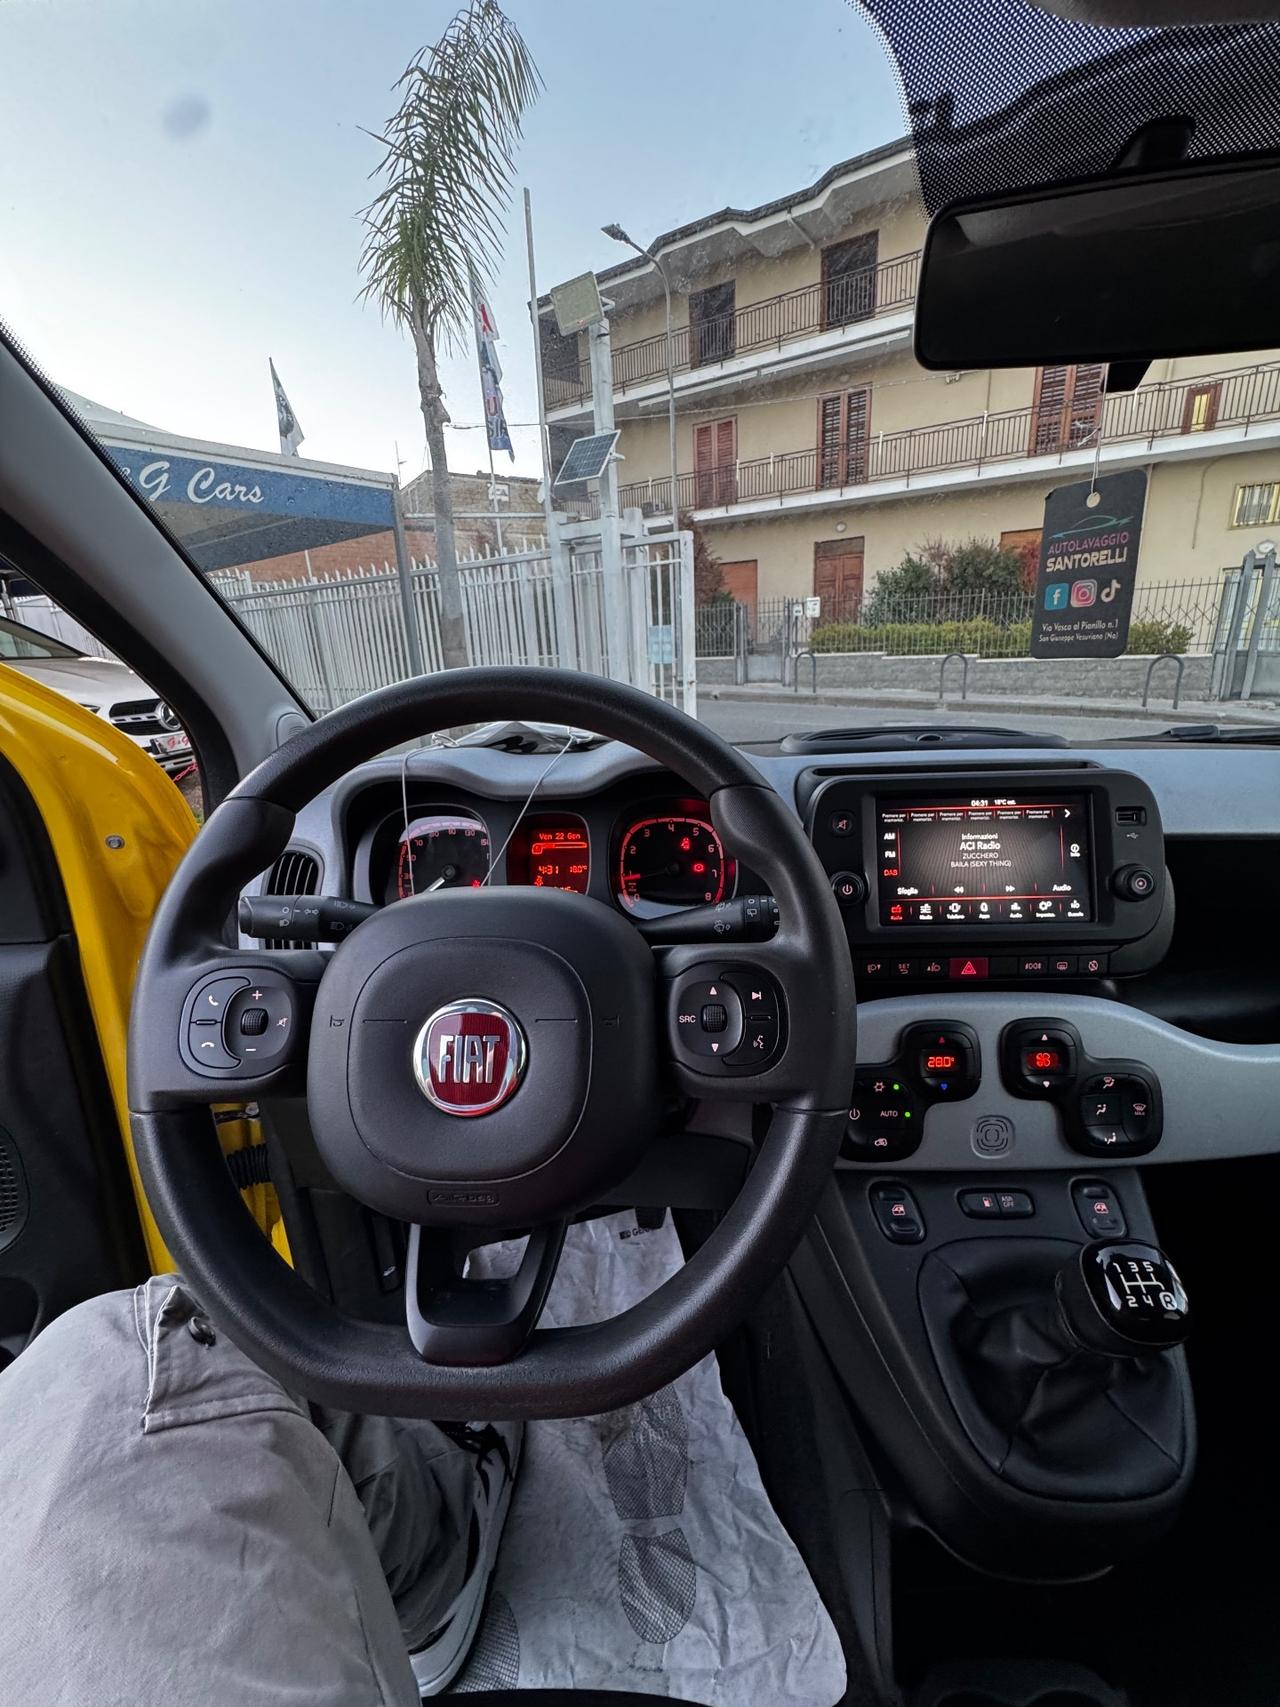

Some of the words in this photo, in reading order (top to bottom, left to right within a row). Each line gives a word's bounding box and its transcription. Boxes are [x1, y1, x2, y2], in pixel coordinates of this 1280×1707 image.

[187, 467, 264, 503] Cars
[1047, 531, 1130, 555] AUTOLAVAGGIO
[1045, 546, 1128, 573] SANTORELLI
[1042, 623, 1052, 631] Via
[1073, 620, 1080, 630] al
[1081, 620, 1106, 630] Pianillo
[1039, 634, 1049, 642] San
[1050, 634, 1075, 643] Giuseppe
[1076, 632, 1103, 641] Vesuviano
[970, 799, 988, 807] 04:31
[668, 823, 675, 832] 4
[693, 827, 700, 837] 5
[555, 832, 565, 840] 22
[644, 829, 651, 838] 3
[884, 832, 896, 840] AM
[961, 832, 999, 840] Informazioni
[708, 844, 715, 853] 6
[960, 841, 976, 850] ACI
[977, 840, 1001, 850] Radio
[630, 845, 637, 855] 2
[885, 850, 896, 858] FM
[970, 860, 988, 868] (SEXY
[988, 859, 1012, 868] THING)
[711, 869, 718, 878] 7
[884, 868, 898, 877] DAB
[1052, 883, 1072, 892] Audio
[704, 892, 712, 901] 8
[679, 1015, 696, 1023] SRC
[438, 1034, 501, 1084] FIAT
[880, 1110, 898, 1118] AUTO
[1113, 1262, 1122, 1273] 1
[1128, 1262, 1139, 1272] 3
[1142, 1261, 1154, 1272] 5
[1126, 1296, 1139, 1308] 2
[1142, 1295, 1155, 1307] 4
